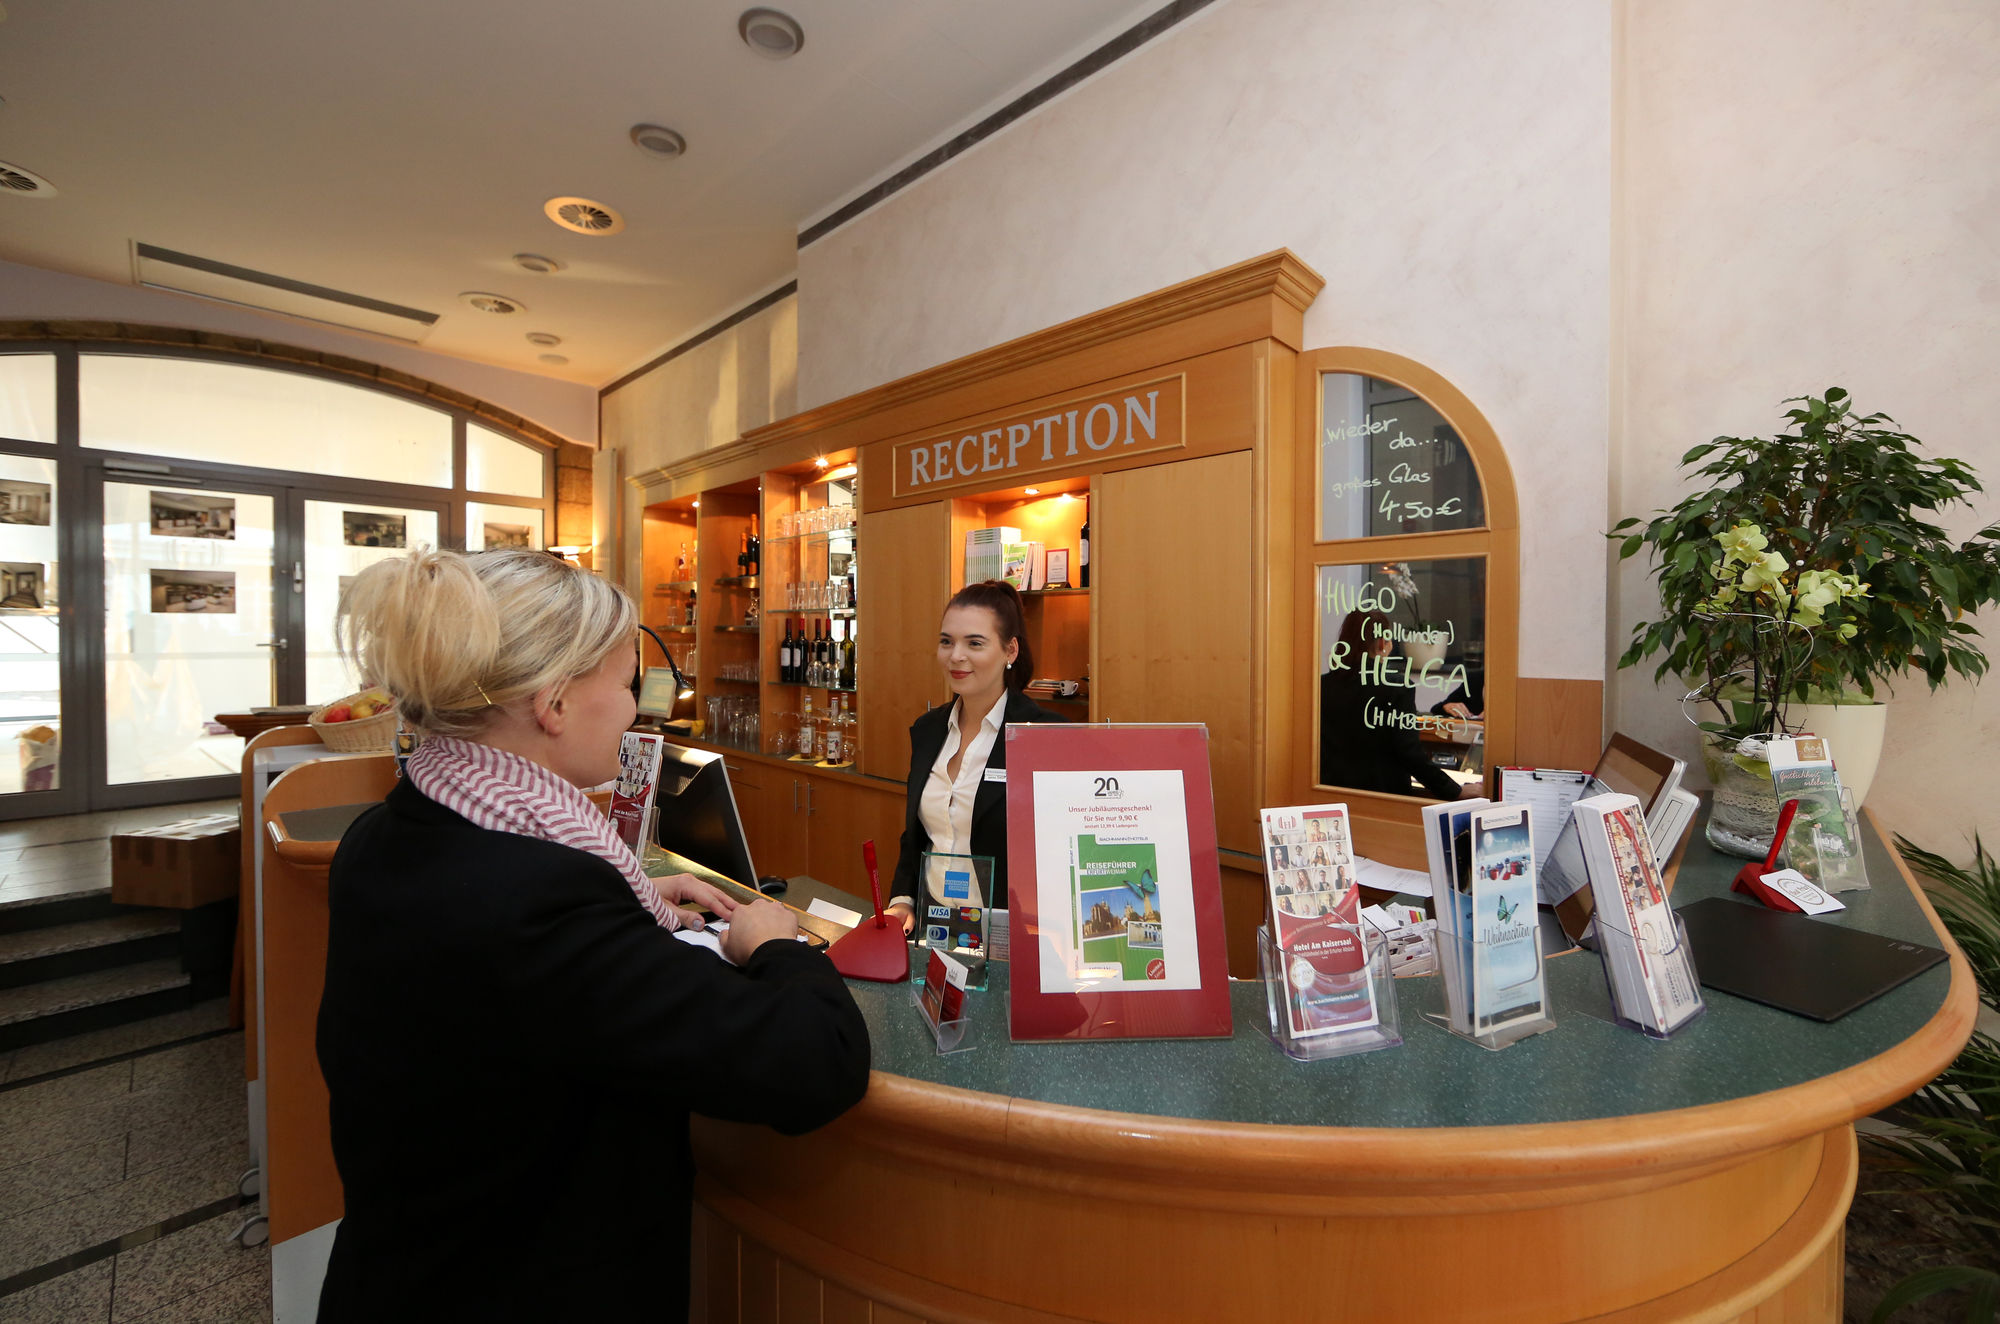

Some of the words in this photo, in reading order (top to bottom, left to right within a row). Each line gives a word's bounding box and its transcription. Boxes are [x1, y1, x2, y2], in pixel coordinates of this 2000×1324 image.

[910, 390, 1159, 486] RECEPTION
[1389, 463, 1431, 484] Glas
[1325, 577, 1396, 616] HUGO
[1328, 641, 1351, 670] &
[1358, 652, 1471, 698] HELGA
[1094, 777, 1119, 797] 20
[1088, 804, 1152, 814] Jubiläumsgeschenk!
[1086, 861, 1137, 869] REISEFÜHRER
[930, 908, 950, 916] VISA
[1293, 943, 1310, 952] Hotel
